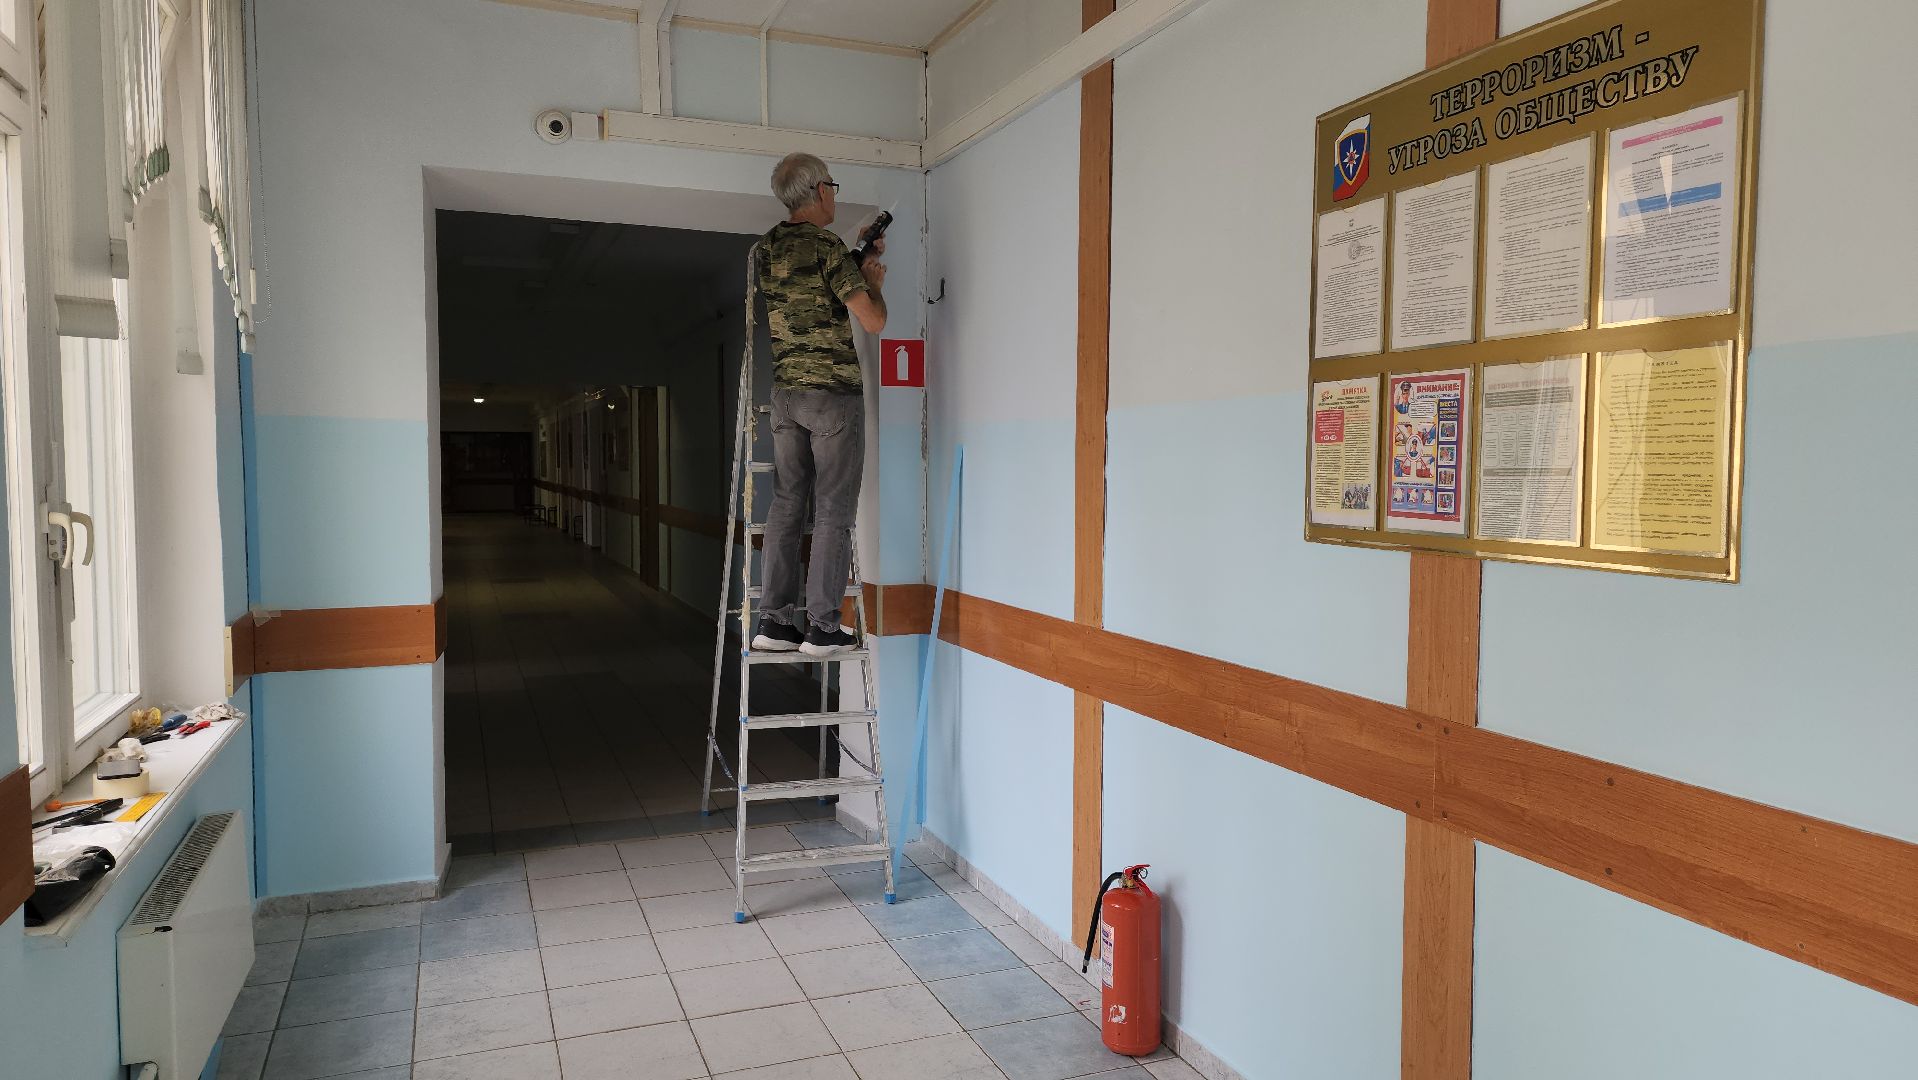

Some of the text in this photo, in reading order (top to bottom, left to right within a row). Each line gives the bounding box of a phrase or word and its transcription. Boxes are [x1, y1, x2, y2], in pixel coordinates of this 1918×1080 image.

[1388, 116, 1487, 175] УГРОЗА
[1495, 45, 1699, 139] ОБЩЕСТВУ
[1430, 24, 1624, 121] ТЕРРОРИЗМ
